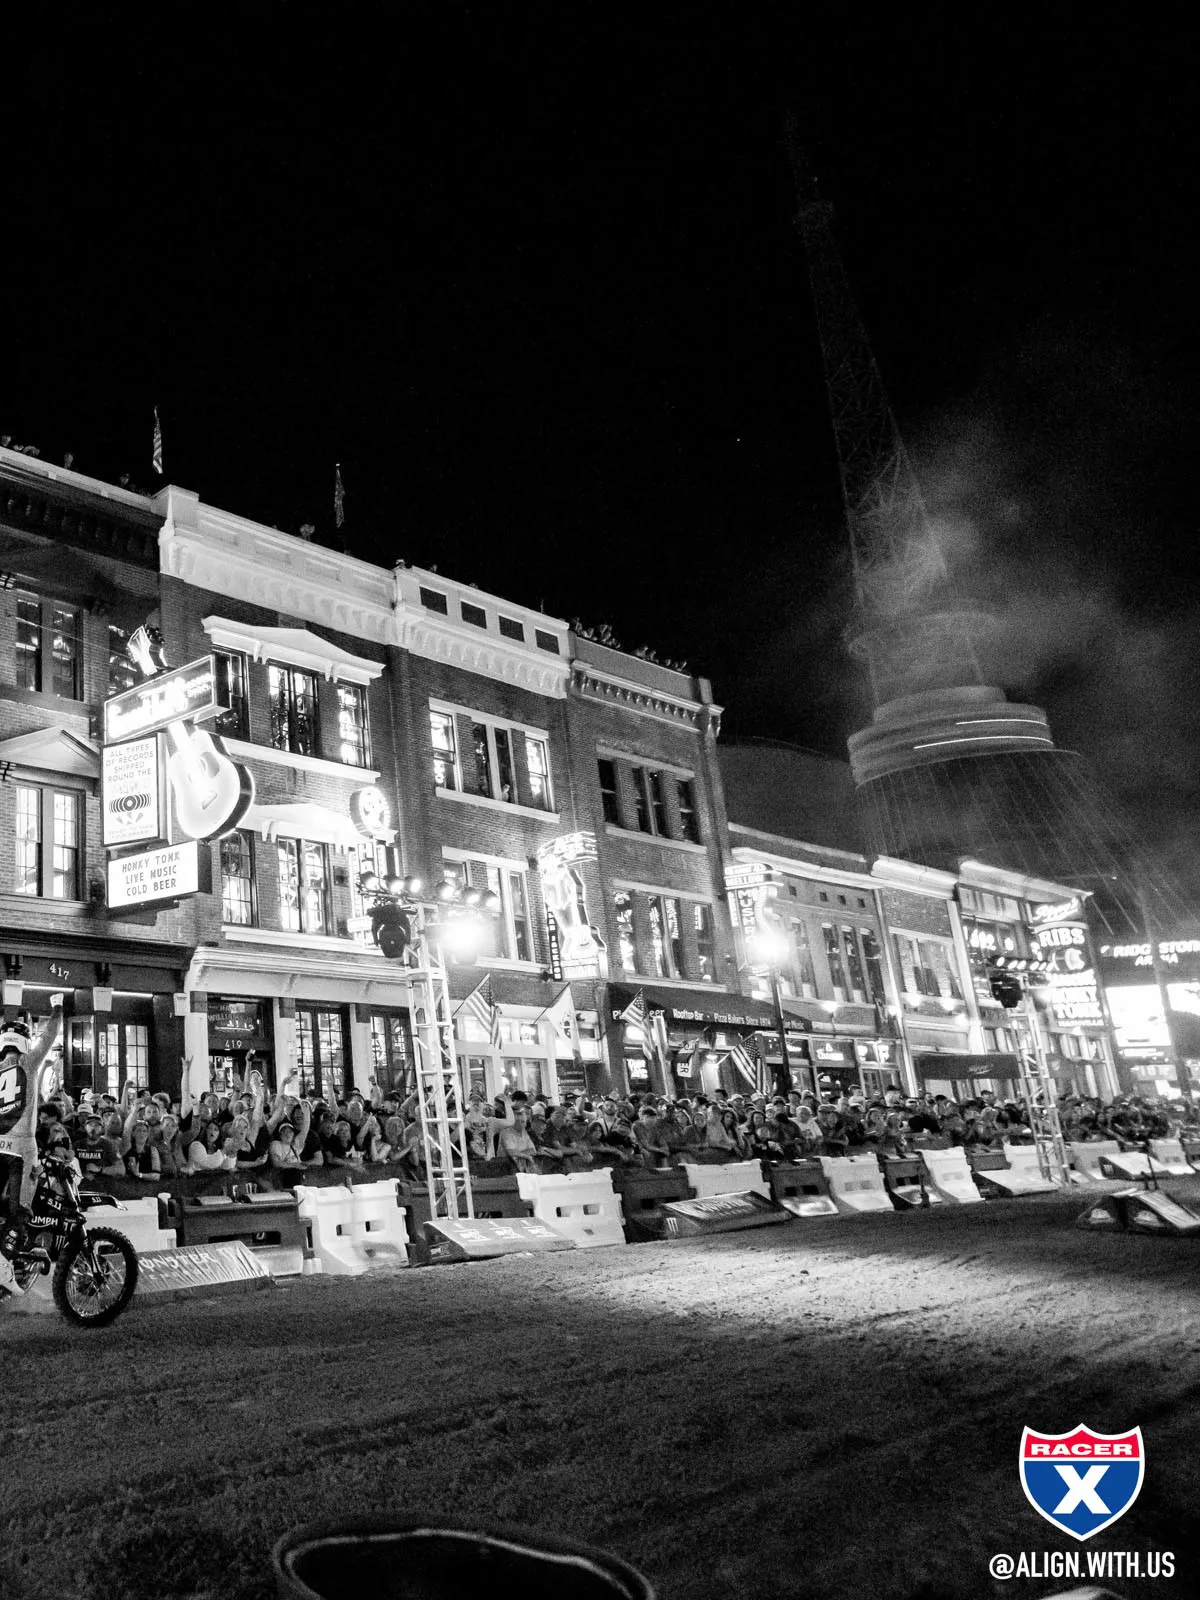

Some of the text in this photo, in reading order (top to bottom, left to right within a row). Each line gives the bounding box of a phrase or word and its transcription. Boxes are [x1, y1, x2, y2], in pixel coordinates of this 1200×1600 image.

[110, 743, 149, 757] ALL TYPES
[119, 750, 154, 763] RECORDS
[107, 767, 152, 782] ROUND THE
[114, 761, 145, 773] SHIPPED
[122, 858, 150, 873] HONKY
[126, 864, 177, 885] LIVE MUSIC
[126, 878, 177, 897] COLD BEER
[1038, 927, 1085, 947] RIBS
[49, 963, 70, 980] 417
[672, 1008, 695, 1019] Rooftop
[694, 1010, 704, 1021] Bar
[225, 1039, 242, 1049] 419
[31, 1215, 58, 1226] UMPH
[138, 1252, 213, 1273] ONSTER
